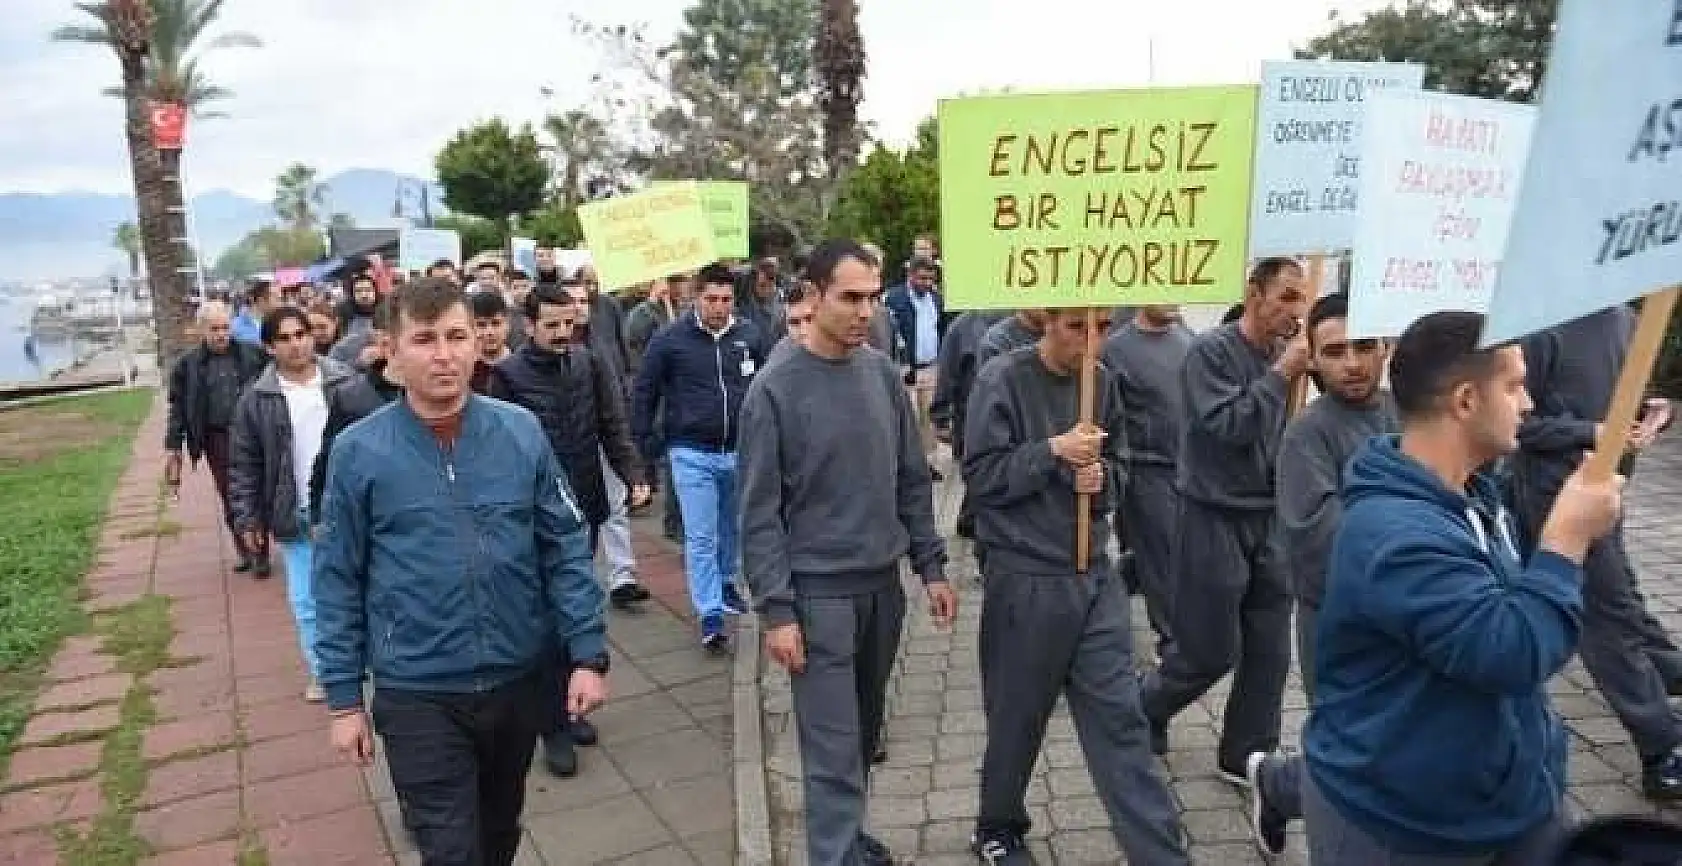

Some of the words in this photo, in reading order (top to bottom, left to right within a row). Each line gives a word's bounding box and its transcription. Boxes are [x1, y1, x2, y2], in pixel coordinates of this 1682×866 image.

[989, 120, 1219, 177] ENGELSİZ
[1083, 184, 1208, 229] HAYAT
[1005, 238, 1219, 289] İSTİYORUZ
